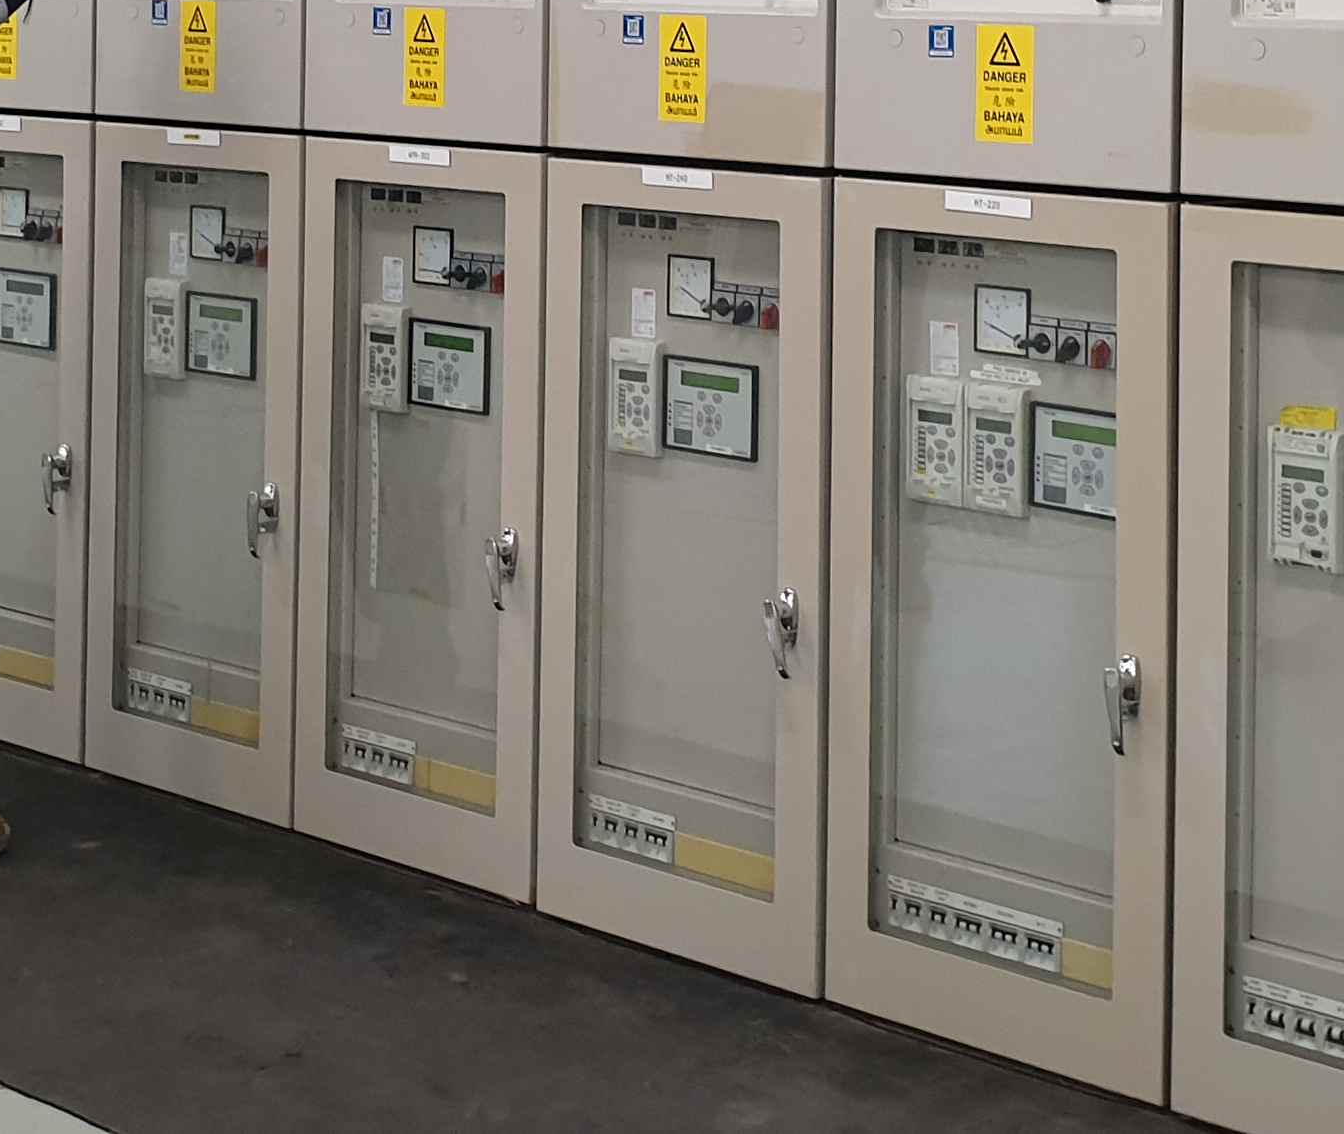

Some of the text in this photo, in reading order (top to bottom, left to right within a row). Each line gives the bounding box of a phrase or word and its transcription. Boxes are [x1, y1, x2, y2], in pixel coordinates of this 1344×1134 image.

[408, 46, 440, 57] DANGER
[664, 56, 701, 68] DANGER
[983, 70, 1026, 84] DANGER
[409, 79, 438, 90] BAHAYA
[665, 92, 699, 104] BAHAYA
[983, 110, 1025, 124] BAHAYA
